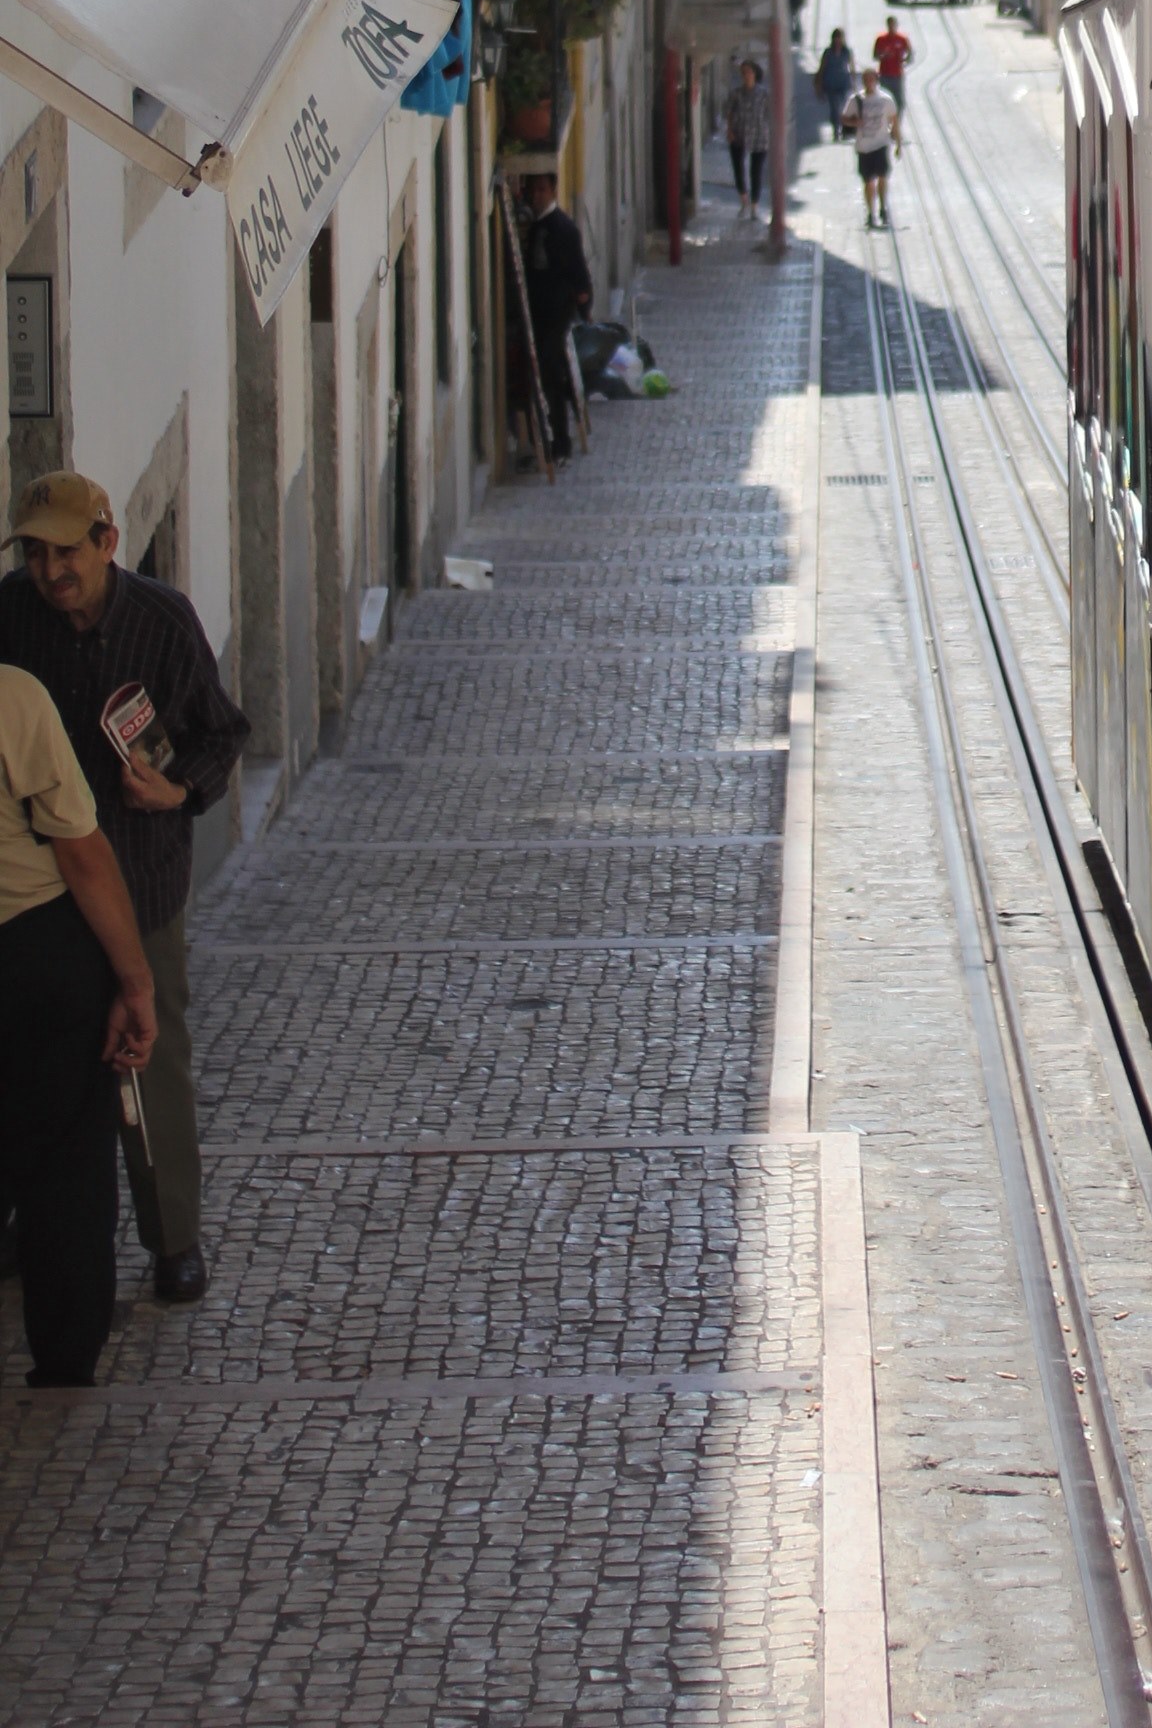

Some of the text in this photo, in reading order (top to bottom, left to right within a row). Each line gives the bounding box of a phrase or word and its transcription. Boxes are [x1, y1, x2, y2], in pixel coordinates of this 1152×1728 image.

[240, 0, 425, 298] CASA LIEGE TOFA
